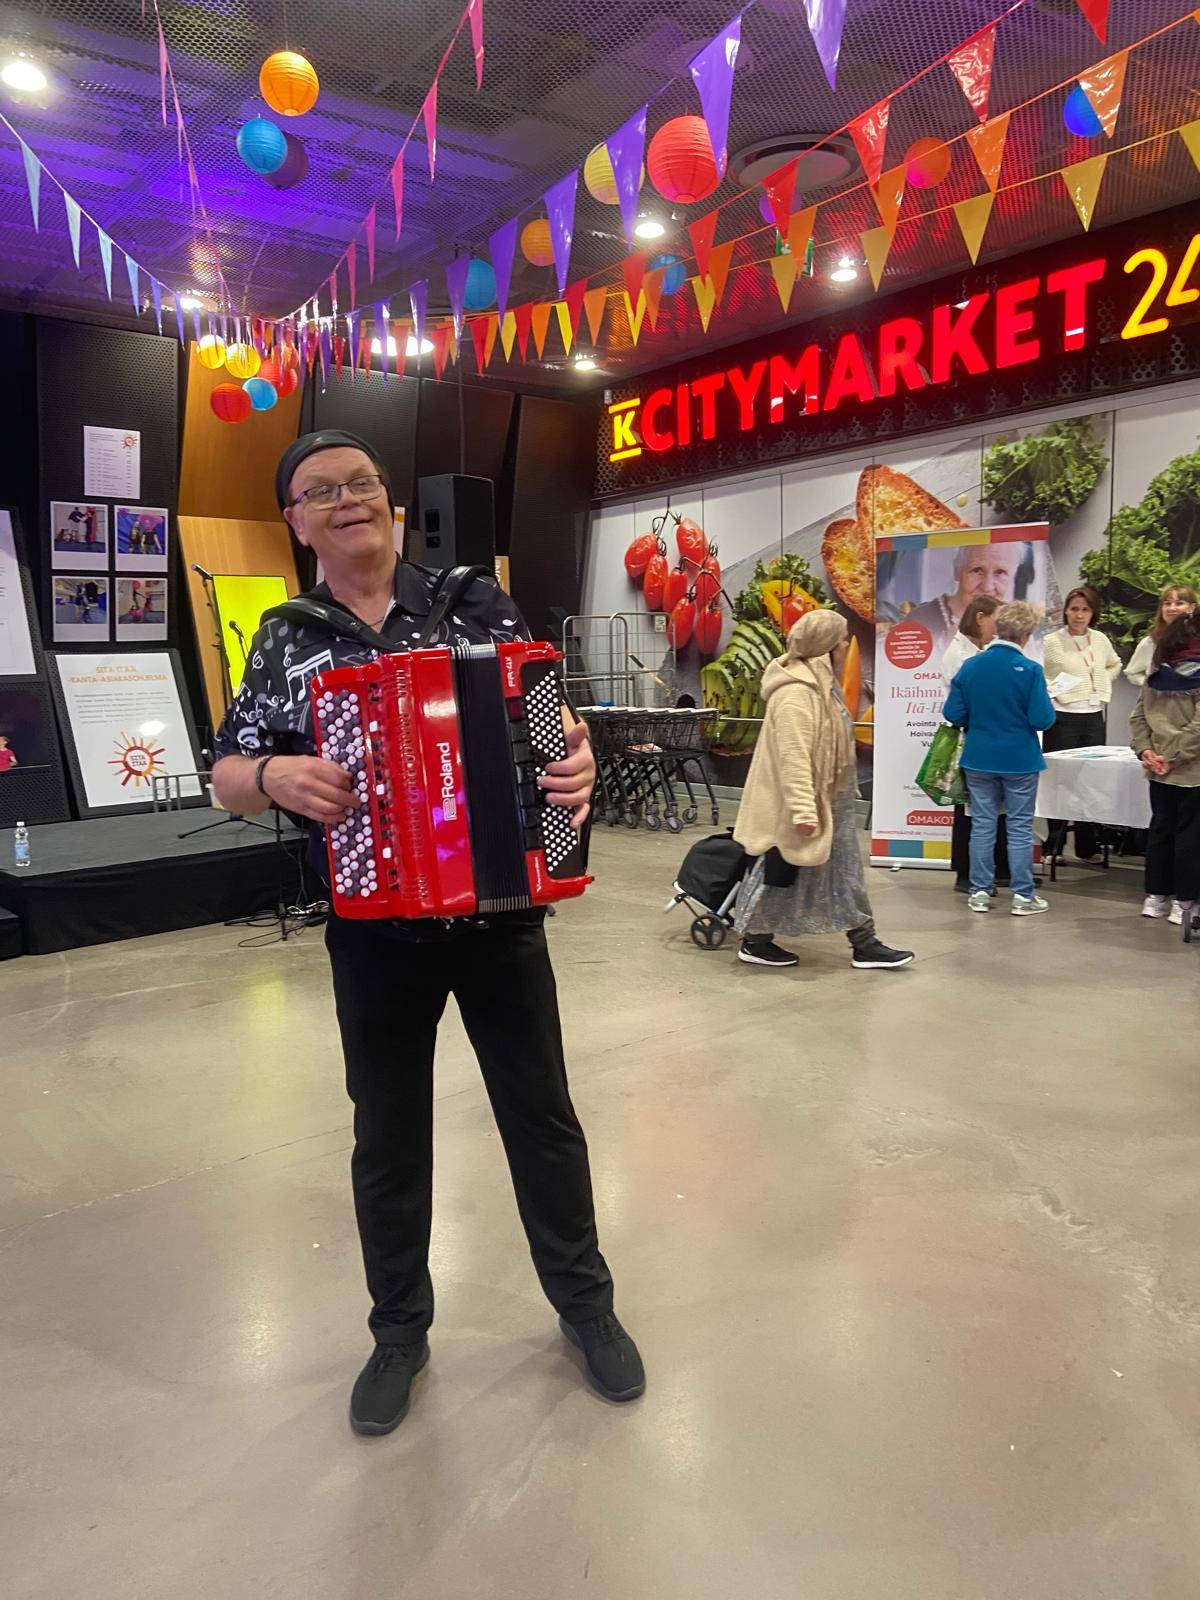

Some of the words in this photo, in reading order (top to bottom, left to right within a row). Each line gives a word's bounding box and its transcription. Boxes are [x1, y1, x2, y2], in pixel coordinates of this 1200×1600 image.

[641, 258, 1106, 451] CITYMARKET
[890, 685, 944, 699] Ikäihmi
[436, 741, 455, 798] Roland
